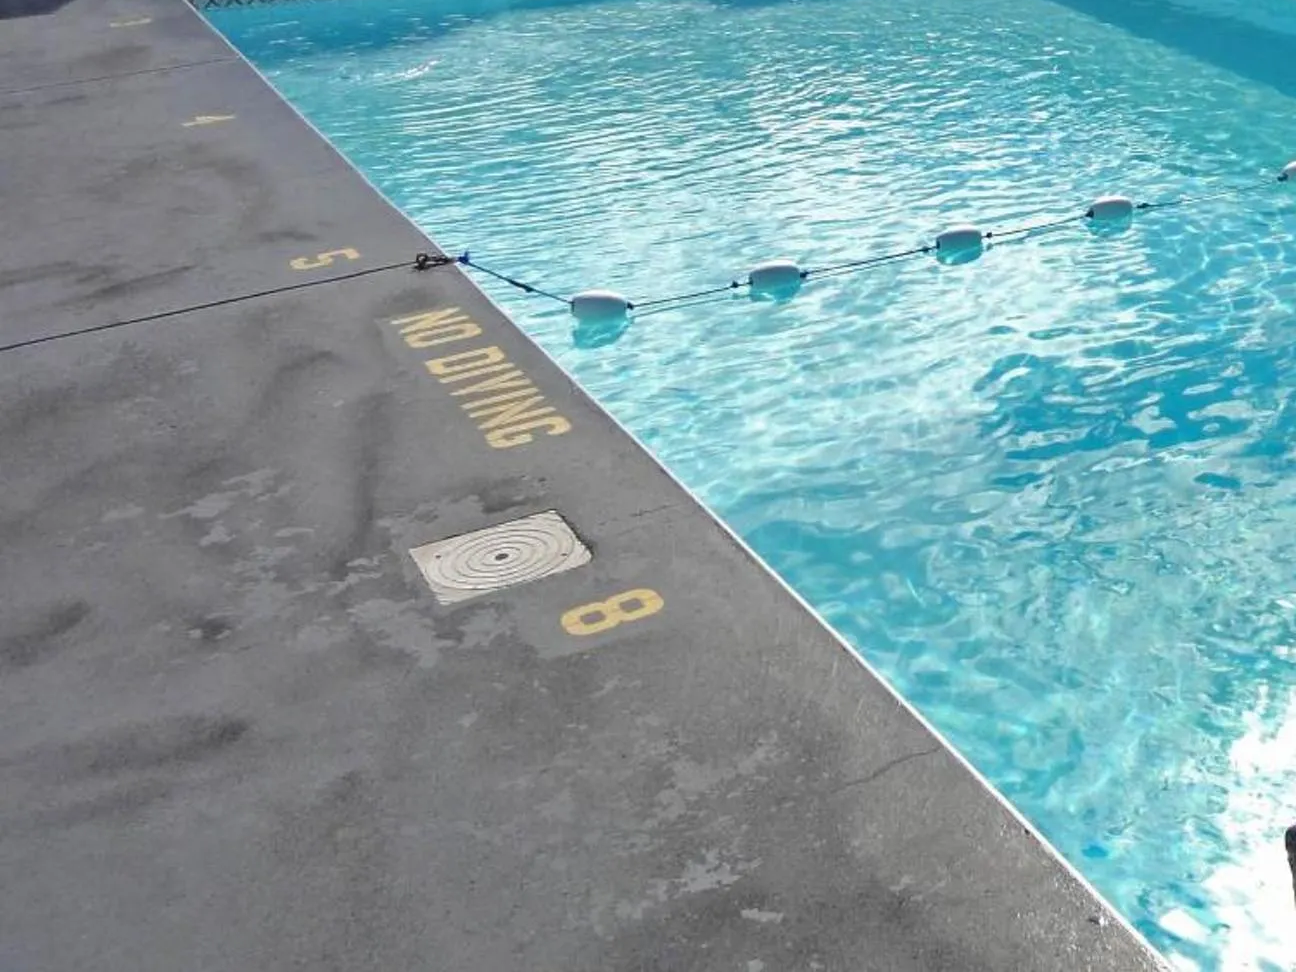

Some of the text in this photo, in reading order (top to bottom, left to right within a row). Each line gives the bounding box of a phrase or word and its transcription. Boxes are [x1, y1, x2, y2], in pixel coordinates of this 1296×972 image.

[290, 248, 360, 269] 5
[390, 307, 572, 449] NO DIVING
[560, 588, 664, 635] 8
